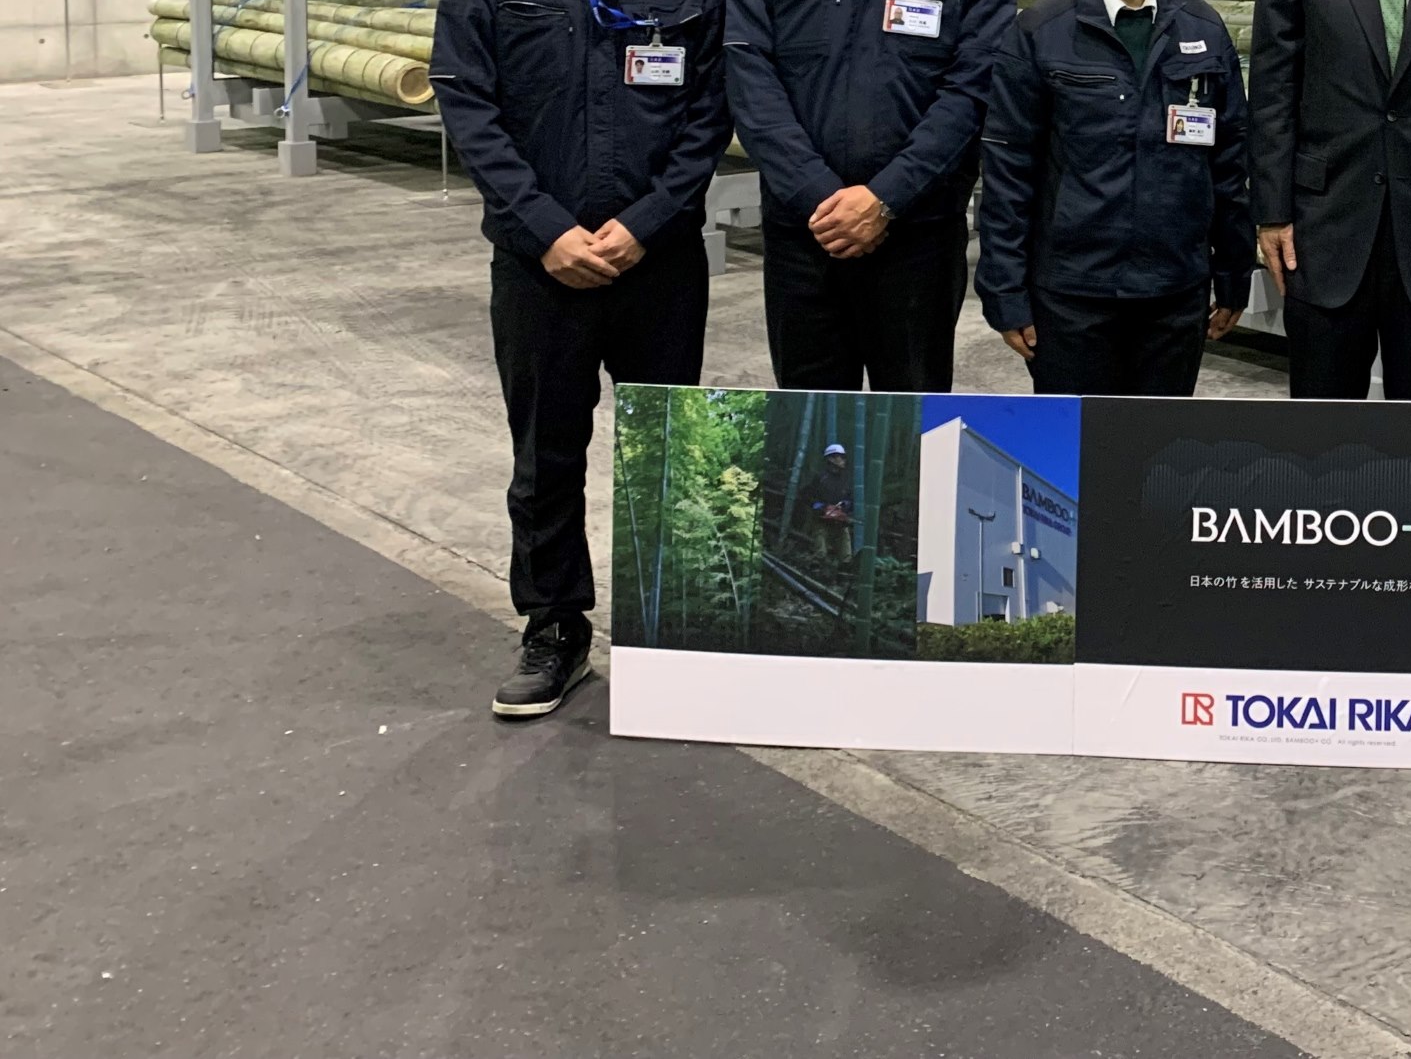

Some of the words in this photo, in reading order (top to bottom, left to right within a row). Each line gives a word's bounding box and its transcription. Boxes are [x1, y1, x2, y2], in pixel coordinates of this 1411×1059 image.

[1190, 575, 1298, 590] 日本の竹を活用した
[1226, 695, 1337, 730] TOKAI
